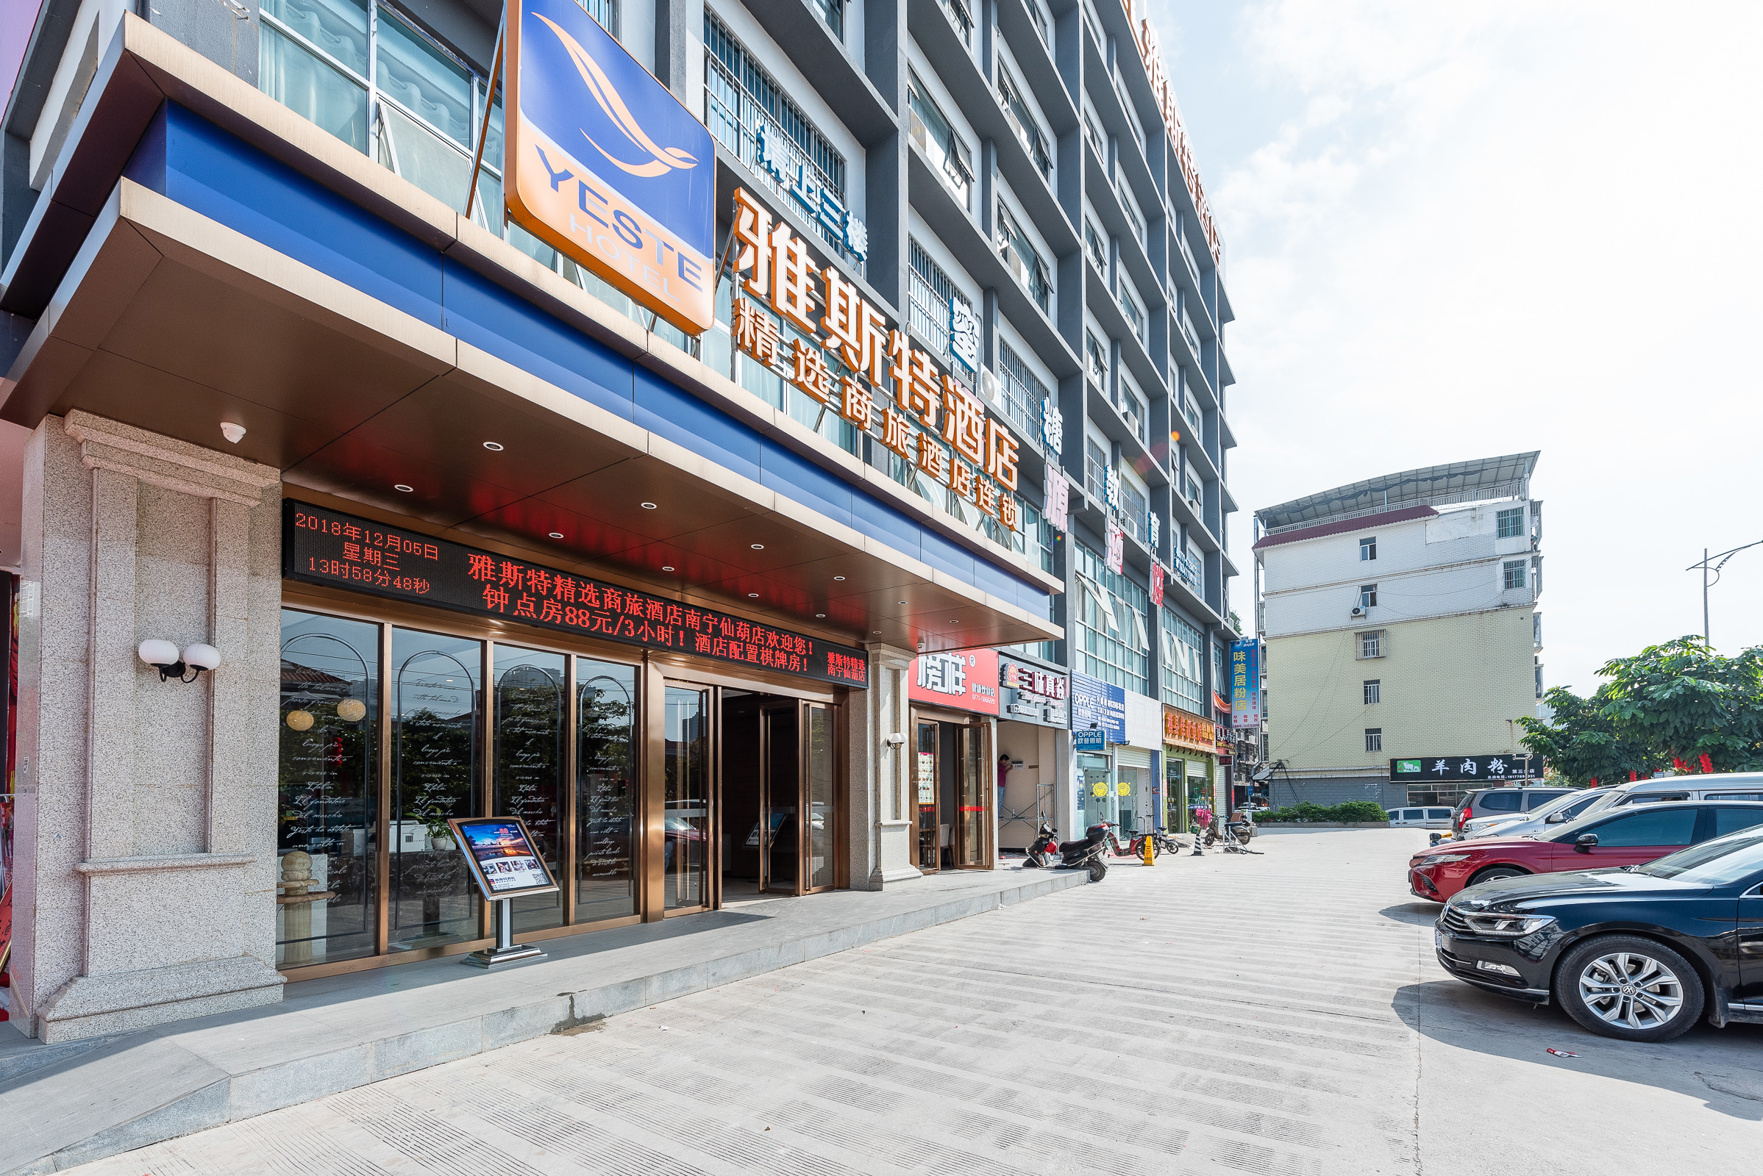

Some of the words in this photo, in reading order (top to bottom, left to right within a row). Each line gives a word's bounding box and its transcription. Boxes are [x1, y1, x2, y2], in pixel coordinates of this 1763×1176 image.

[534, 144, 703, 293] YESTE
[569, 213, 681, 302] HOTEL
[734, 187, 1020, 492] 雅斯特酒店
[734, 298, 1018, 532] 精选商旅酒店连锁
[295, 512, 439, 561] 2018年12月05日
[342, 541, 401, 571] 星期三
[308, 556, 431, 595] 13时58分48秒
[827, 651, 865, 670] 雅斯特精选
[827, 664, 865, 683] 南宁仙葫店
[1233, 651, 1247, 711] 味美居粉店
[1431, 757, 1509, 776] 羊肉粉
